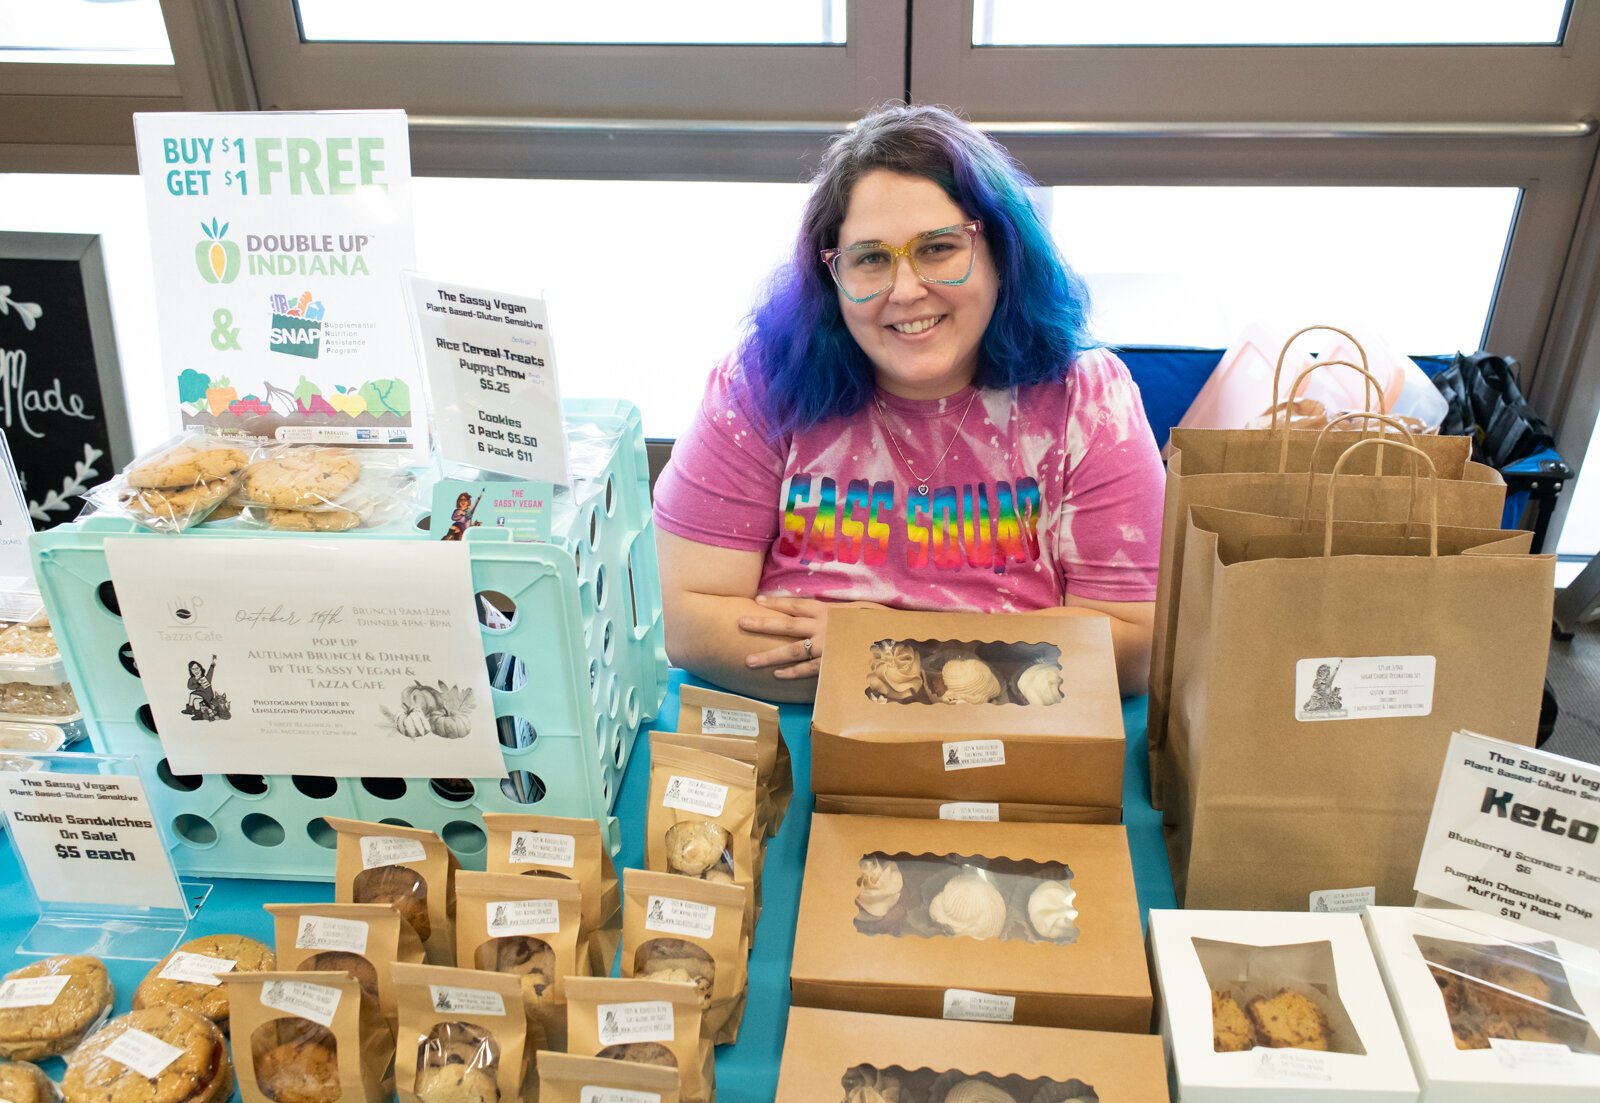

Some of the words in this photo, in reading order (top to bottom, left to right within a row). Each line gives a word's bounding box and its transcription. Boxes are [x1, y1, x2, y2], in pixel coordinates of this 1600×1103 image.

[163, 138, 214, 164] BUY
[222, 137, 246, 164] $1
[255, 137, 388, 196] FREE
[167, 170, 211, 196] GET
[225, 170, 248, 196] $1
[246, 235, 334, 252] DOUBLE
[249, 254, 370, 276] INDIANA
[437, 290, 457, 302] The
[459, 293, 491, 310] Sassy
[493, 298, 527, 314] Vegan
[426, 303, 447, 314] Plant
[505, 316, 544, 330] Sensitive
[211, 308, 242, 351] &
[270, 328, 321, 346] SNAP
[436, 337, 460, 351] Rice
[462, 342, 501, 359] Cereal
[503, 349, 545, 367] Treats
[459, 358, 494, 377] Puppy
[497, 364, 526, 380] Chow
[479, 377, 511, 394] $5.25
[478, 410, 522, 428] Cookies
[467, 424, 476, 435] 3
[478, 426, 505, 441] Pack
[507, 431, 538, 448] $5.50
[477, 441, 485, 452] 6
[487, 443, 514, 459] Pack
[516, 449, 533, 463] $11
[511, 489, 524, 498] THE
[493, 499, 517, 508] SASSY
[519, 499, 543, 508] VEGAN
[778, 472, 895, 567] SASS
[907, 476, 1041, 575] SQUAD
[235, 604, 302, 631] October
[352, 606, 397, 617] BRUNCH
[357, 619, 399, 628] DINNER
[156, 631, 193, 642] Tazza
[194, 631, 223, 642] Cafe
[312, 638, 338, 647] POP
[340, 638, 358, 647] UP
[248, 650, 303, 660] AUTUMN
[307, 651, 362, 661] BRUNCH
[365, 651, 376, 661] &
[379, 652, 432, 663] DINNER
[268, 664, 284, 674] BY
[289, 664, 313, 674] THE
[316, 665, 354, 675] SASSY
[356, 665, 401, 676] VEGAN
[405, 666, 416, 676] &
[307, 678, 349, 689] TAZZA
[351, 679, 385, 690] CAFE
[253, 699, 308, 707] PHOTOGRAPHY
[1464, 758, 1494, 774] Plant
[1488, 751, 1515, 767] The
[1519, 759, 1566, 783] Sassy
[20, 778, 42, 787] The
[44, 780, 80, 791] Sassy
[83, 781, 120, 792] Vegan
[9, 788, 33, 797] Plant
[96, 793, 139, 802] Sensitive
[14, 811, 63, 824] Cookie
[66, 814, 153, 829] Sandwiches
[1480, 786, 1600, 845] Keto
[59, 829, 79, 840] On
[81, 830, 118, 842] Sale!
[55, 843, 81, 860] $5
[85, 848, 136, 862] each
[1448, 830, 1512, 858] Blueberry
[1515, 850, 1562, 872] Scones
[1565, 866, 1574, 875] 2
[1444, 865, 1494, 887] Pumpkin
[1496, 882, 1562, 908] Chocolate
[1565, 902, 1593, 919] Chip
[1467, 884, 1516, 907] Muffins
[1519, 900, 1527, 910] 4
[1530, 905, 1562, 921] Pack
[1500, 907, 1522, 920] $10
